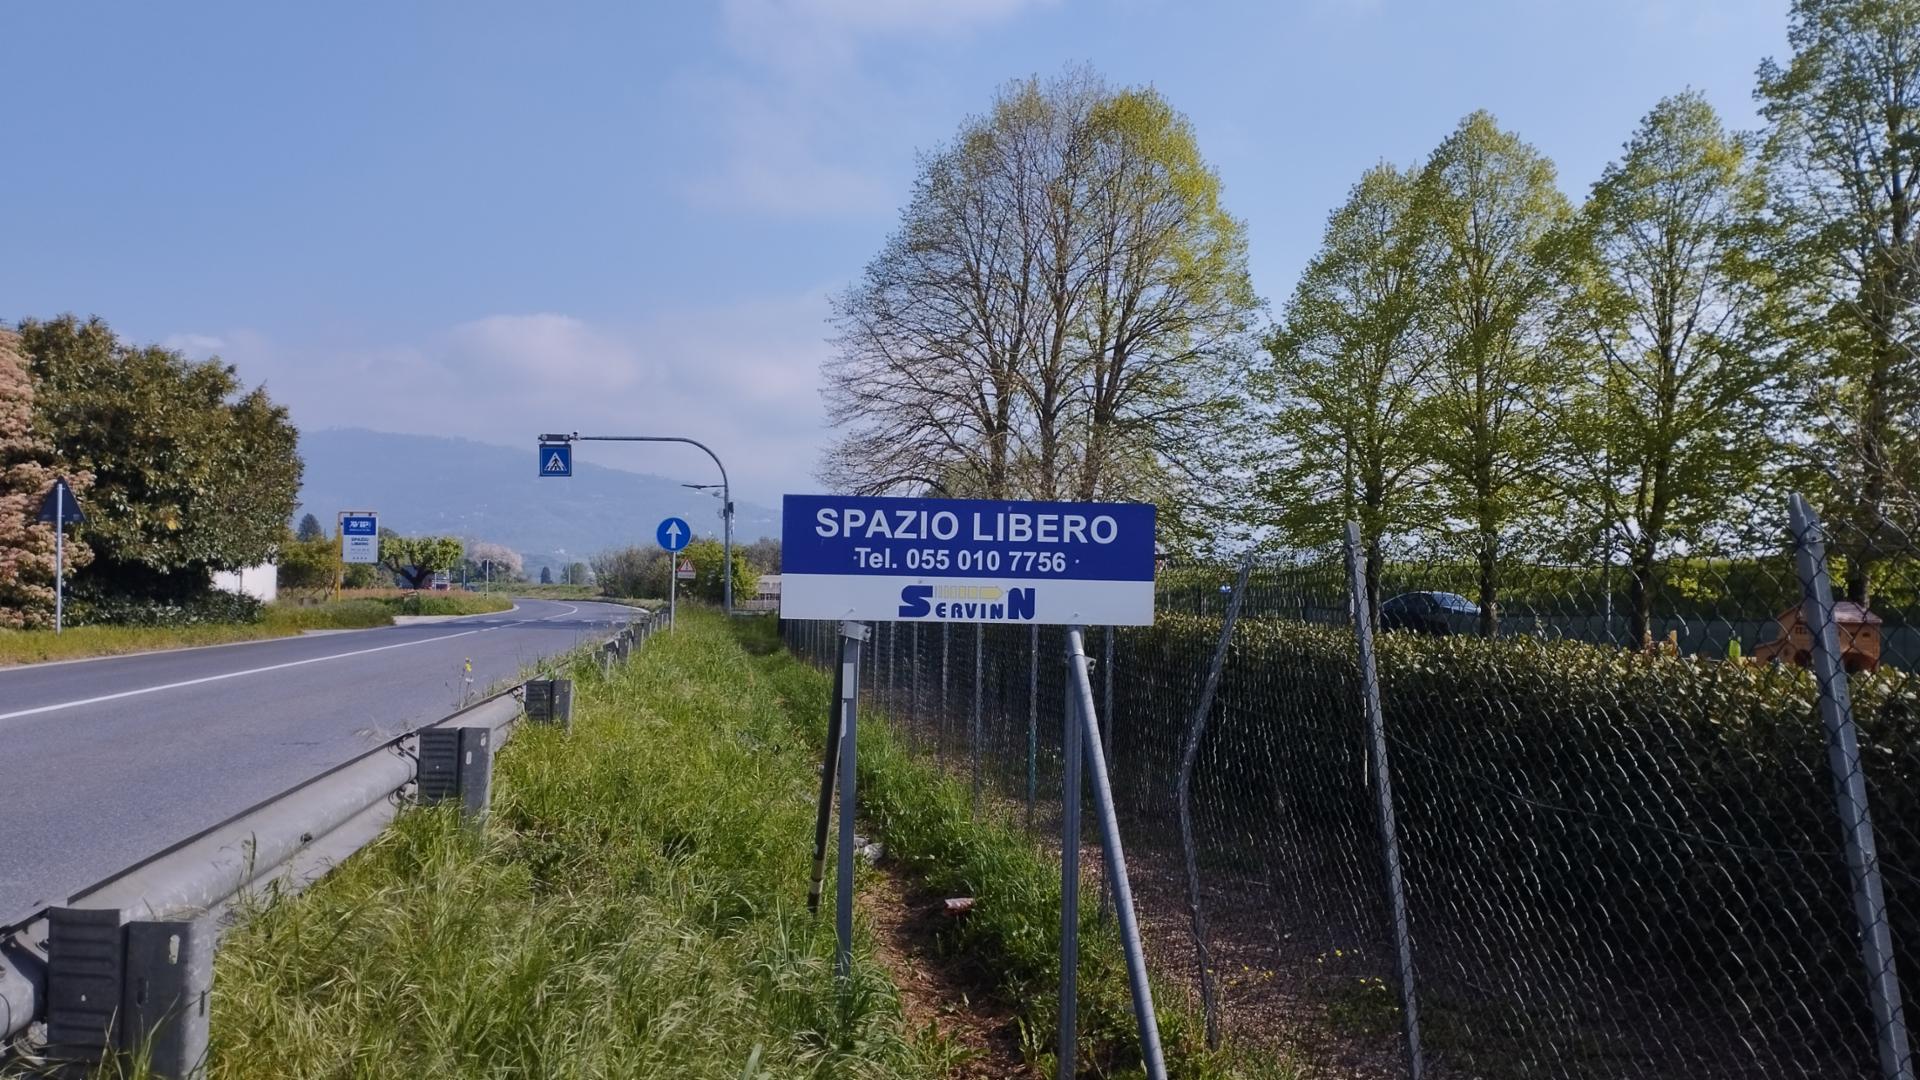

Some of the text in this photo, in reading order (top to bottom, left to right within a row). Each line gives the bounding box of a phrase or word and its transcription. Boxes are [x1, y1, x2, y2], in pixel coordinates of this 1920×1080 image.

[815, 507, 1118, 544] SPAZIO LIBERO
[854, 547, 1066, 573] Tel. 055 010 7756
